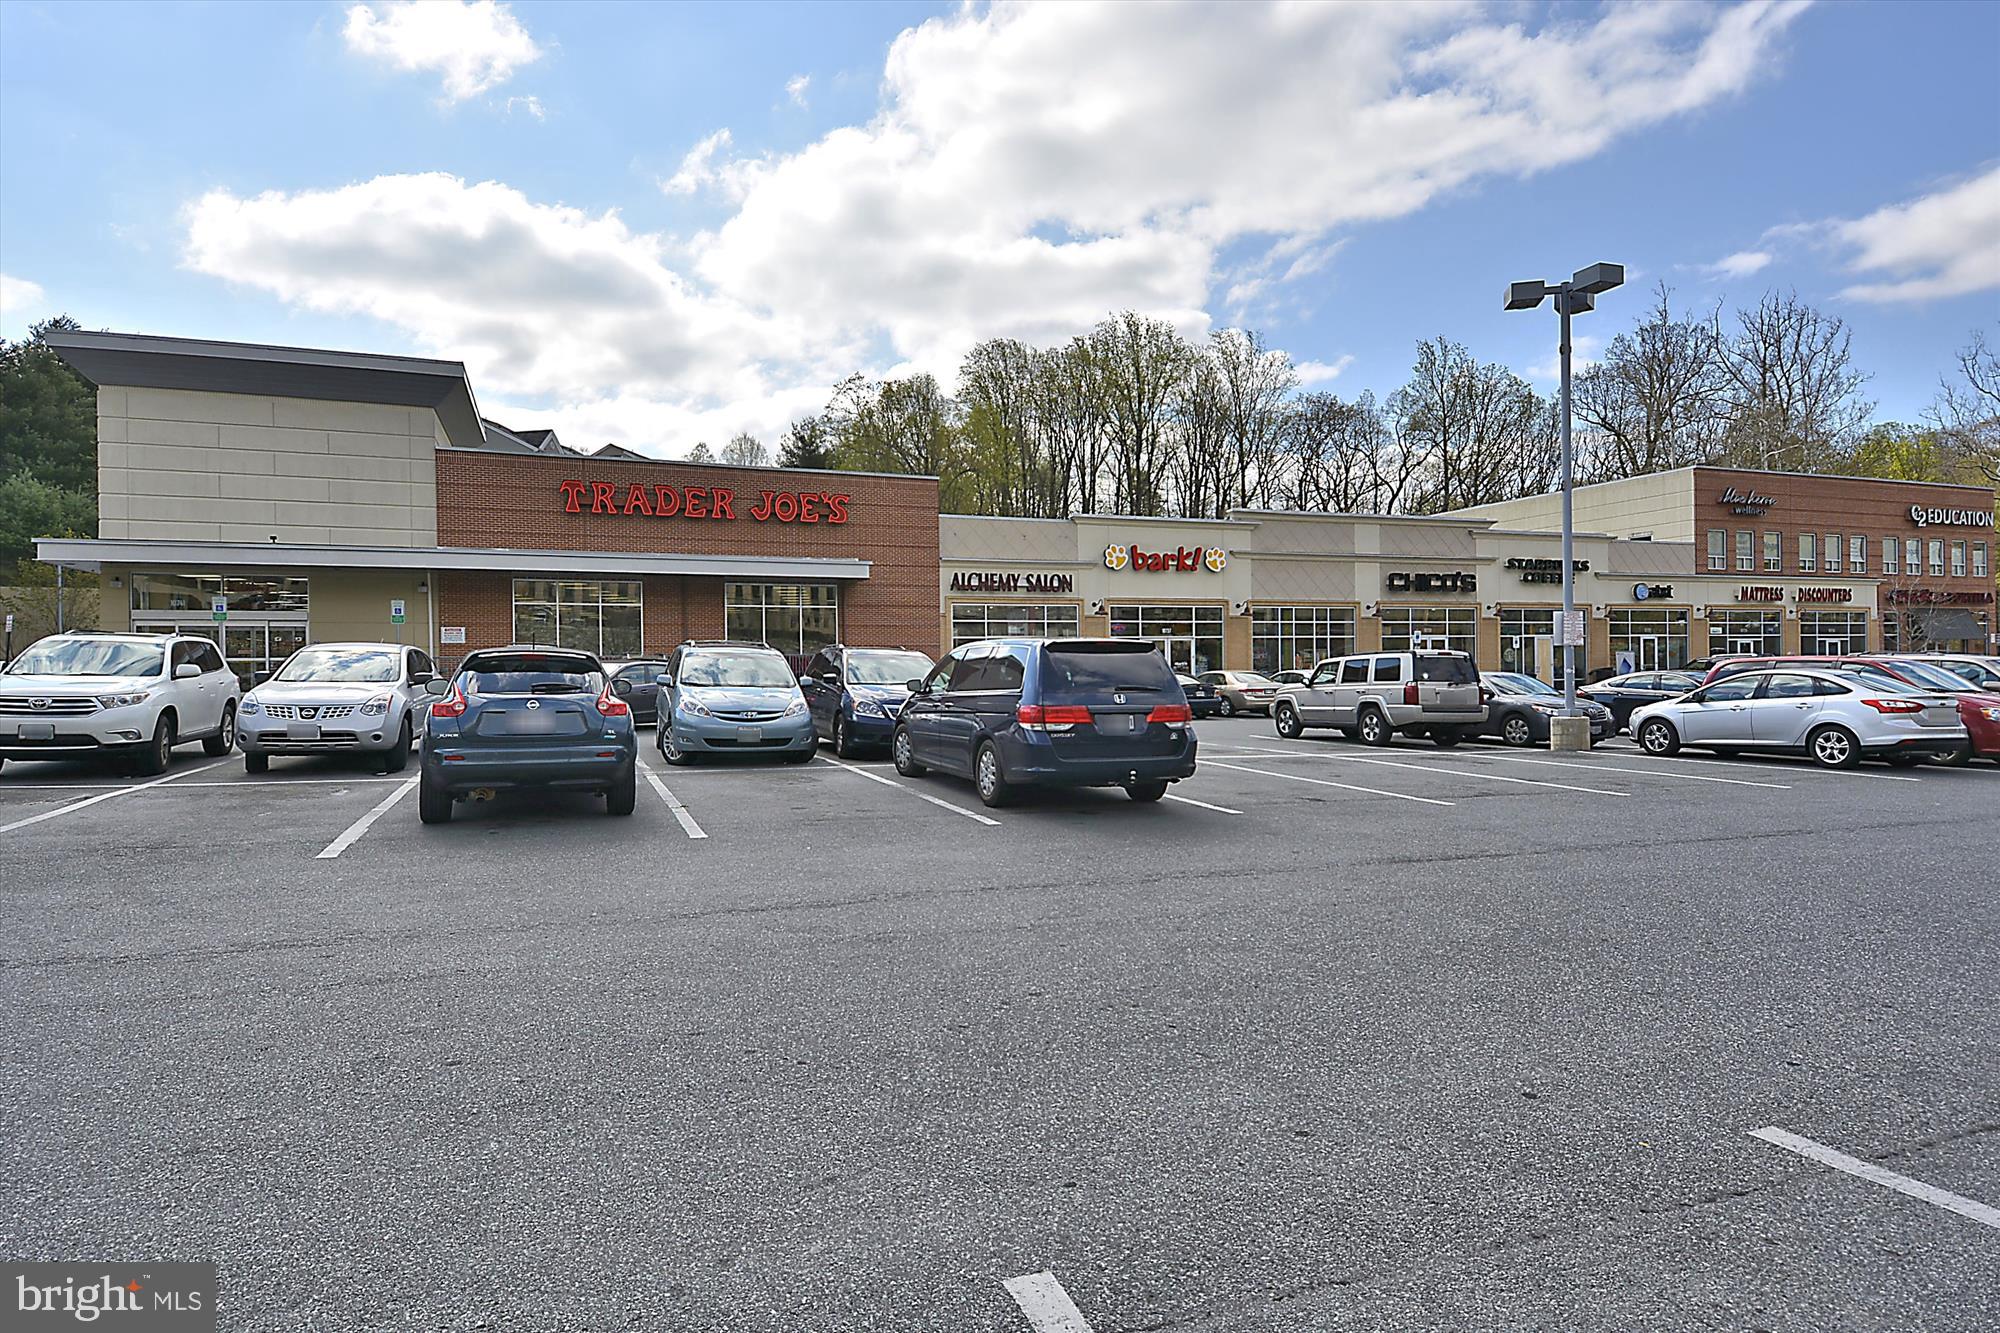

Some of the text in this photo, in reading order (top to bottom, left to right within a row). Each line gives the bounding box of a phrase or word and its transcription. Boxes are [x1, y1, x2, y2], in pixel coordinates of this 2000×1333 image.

[560, 480, 849, 523] TRADER JOE'S
[1734, 505, 1767, 516] wellness
[1911, 505, 1994, 527] C2 EDUCATION
[1131, 545, 1203, 572] bark!
[1507, 558, 1590, 571] STARBUKS
[950, 572, 1073, 592] ALCHEMY SALON
[1388, 571, 1477, 592] CHICO'S
[1740, 586, 1852, 602] MATTRESS DISCOUNTERS
